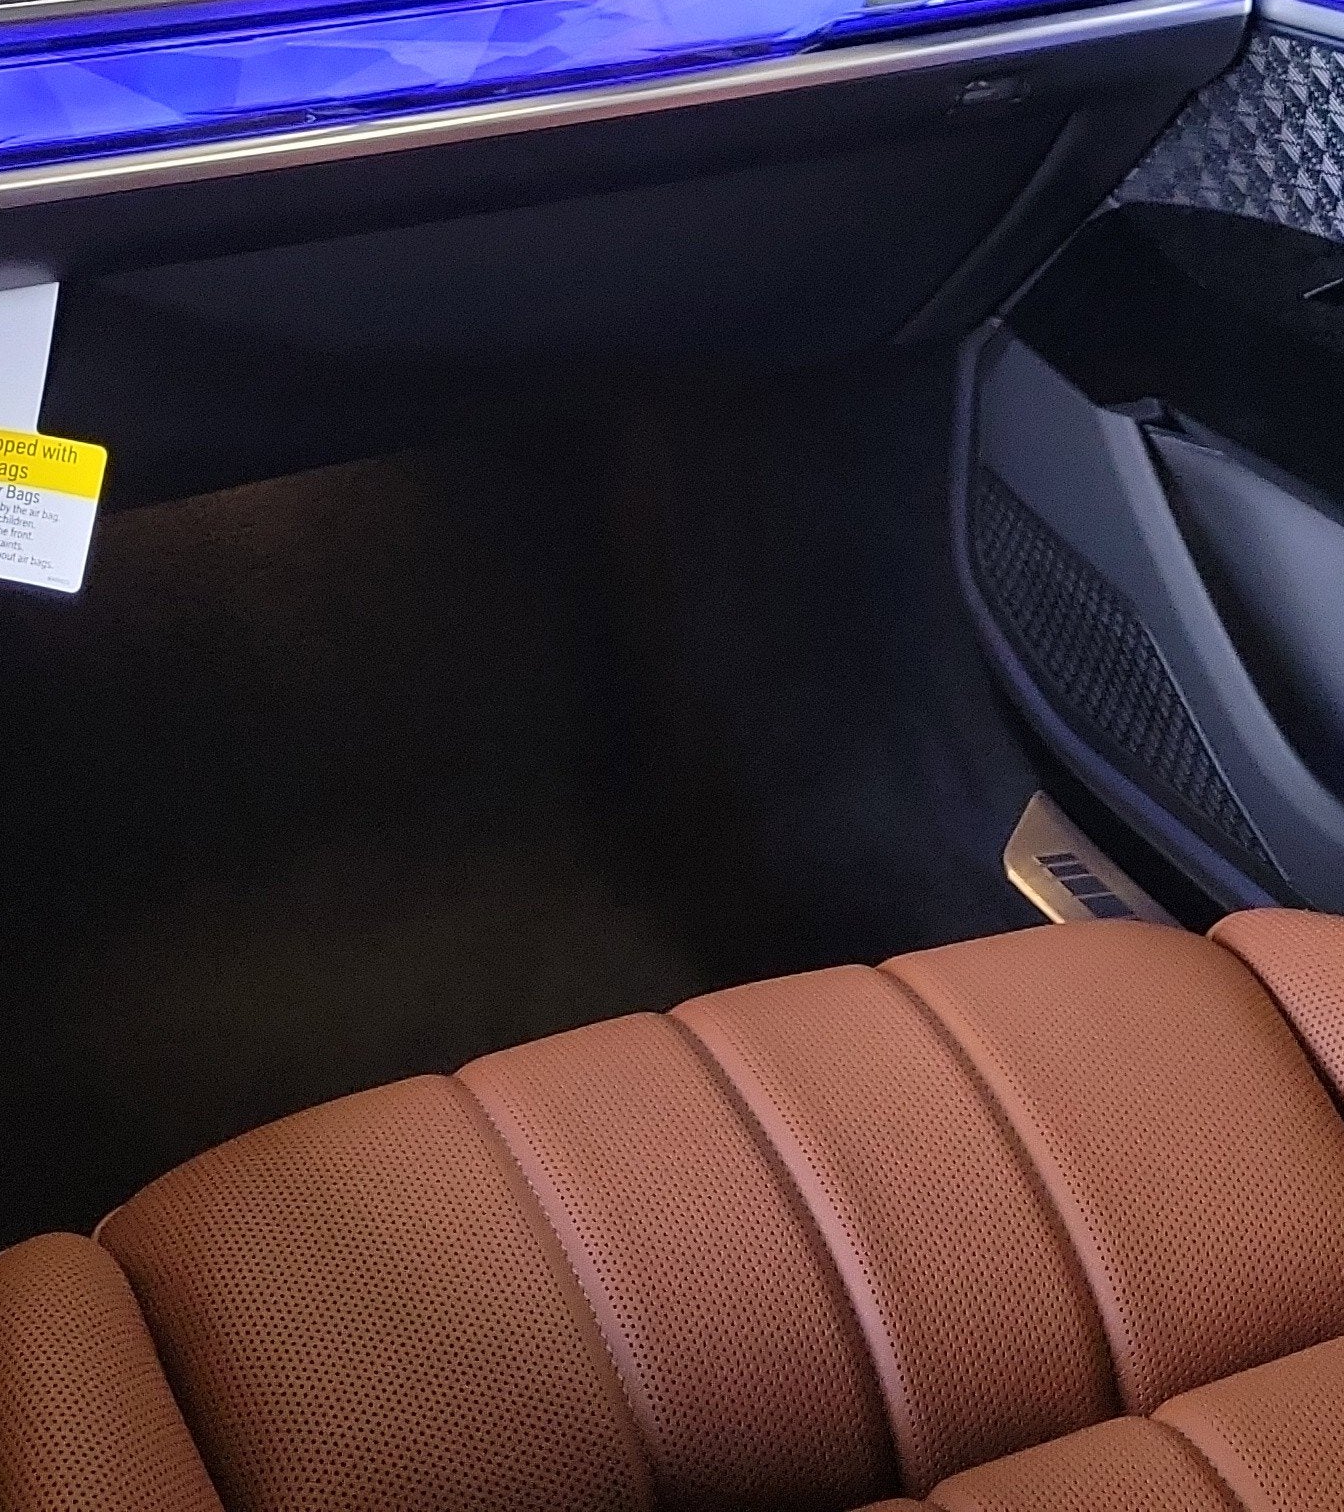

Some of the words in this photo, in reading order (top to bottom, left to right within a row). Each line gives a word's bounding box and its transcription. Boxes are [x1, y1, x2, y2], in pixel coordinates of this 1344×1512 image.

[43, 443, 78, 464] with
[6, 485, 40, 505] Bags
[0, 503, 10, 514] by
[13, 505, 27, 514] the
